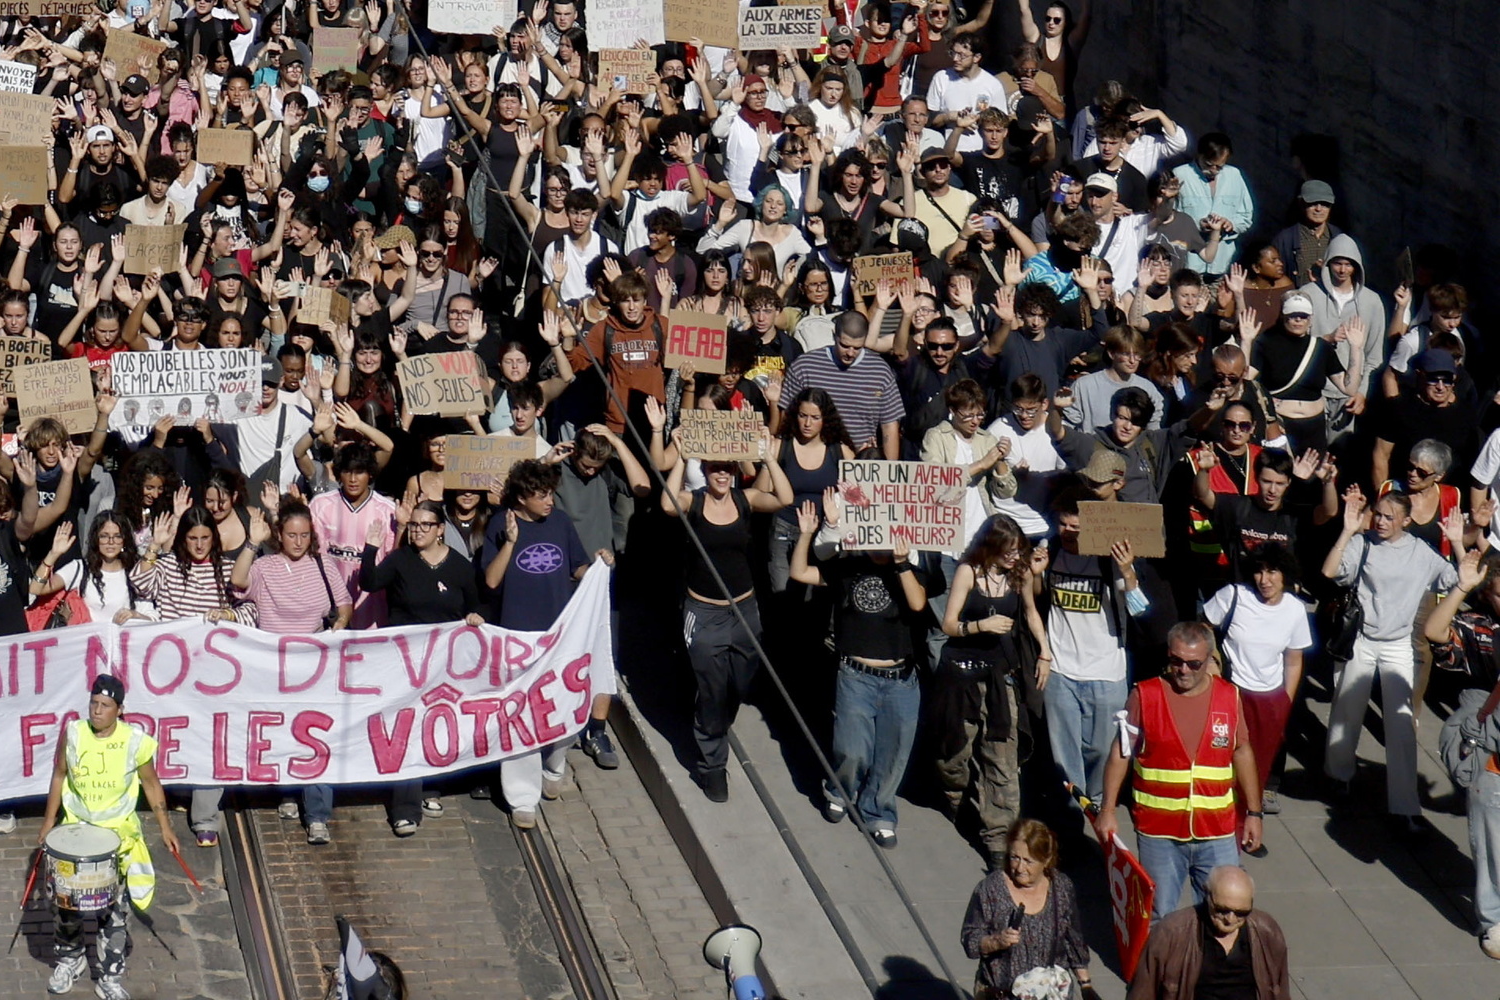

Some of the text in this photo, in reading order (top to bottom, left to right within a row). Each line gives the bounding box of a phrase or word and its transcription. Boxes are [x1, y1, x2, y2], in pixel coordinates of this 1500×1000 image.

[745, 9, 821, 22] AUX ARMES
[742, 23, 816, 36] LA JEUNESSE
[20, 78, 33, 88] PAS
[859, 279, 876, 293] PAS
[669, 324, 725, 360] ACAB
[112, 350, 258, 373] VOS POUBELLES SONT
[402, 357, 435, 380] NOS
[114, 371, 216, 395] REMPLAÇABLES
[405, 382, 431, 409] NOS
[681, 419, 735, 430] COMME UN
[687, 410, 758, 420] QUI EST QUI
[682, 429, 700, 440] QUI
[684, 441, 749, 453] SON CHIEN
[842, 461, 963, 487] POUR UN AVENIR
[873, 484, 936, 504] MEILLEUR
[904, 504, 962, 525] MUTILER
[858, 525, 883, 545] DES
[85, 627, 243, 696] NOS
[212, 709, 335, 783] LES
[367, 652, 593, 773] VÔTRES
[1213, 724, 1228, 736] cgt
